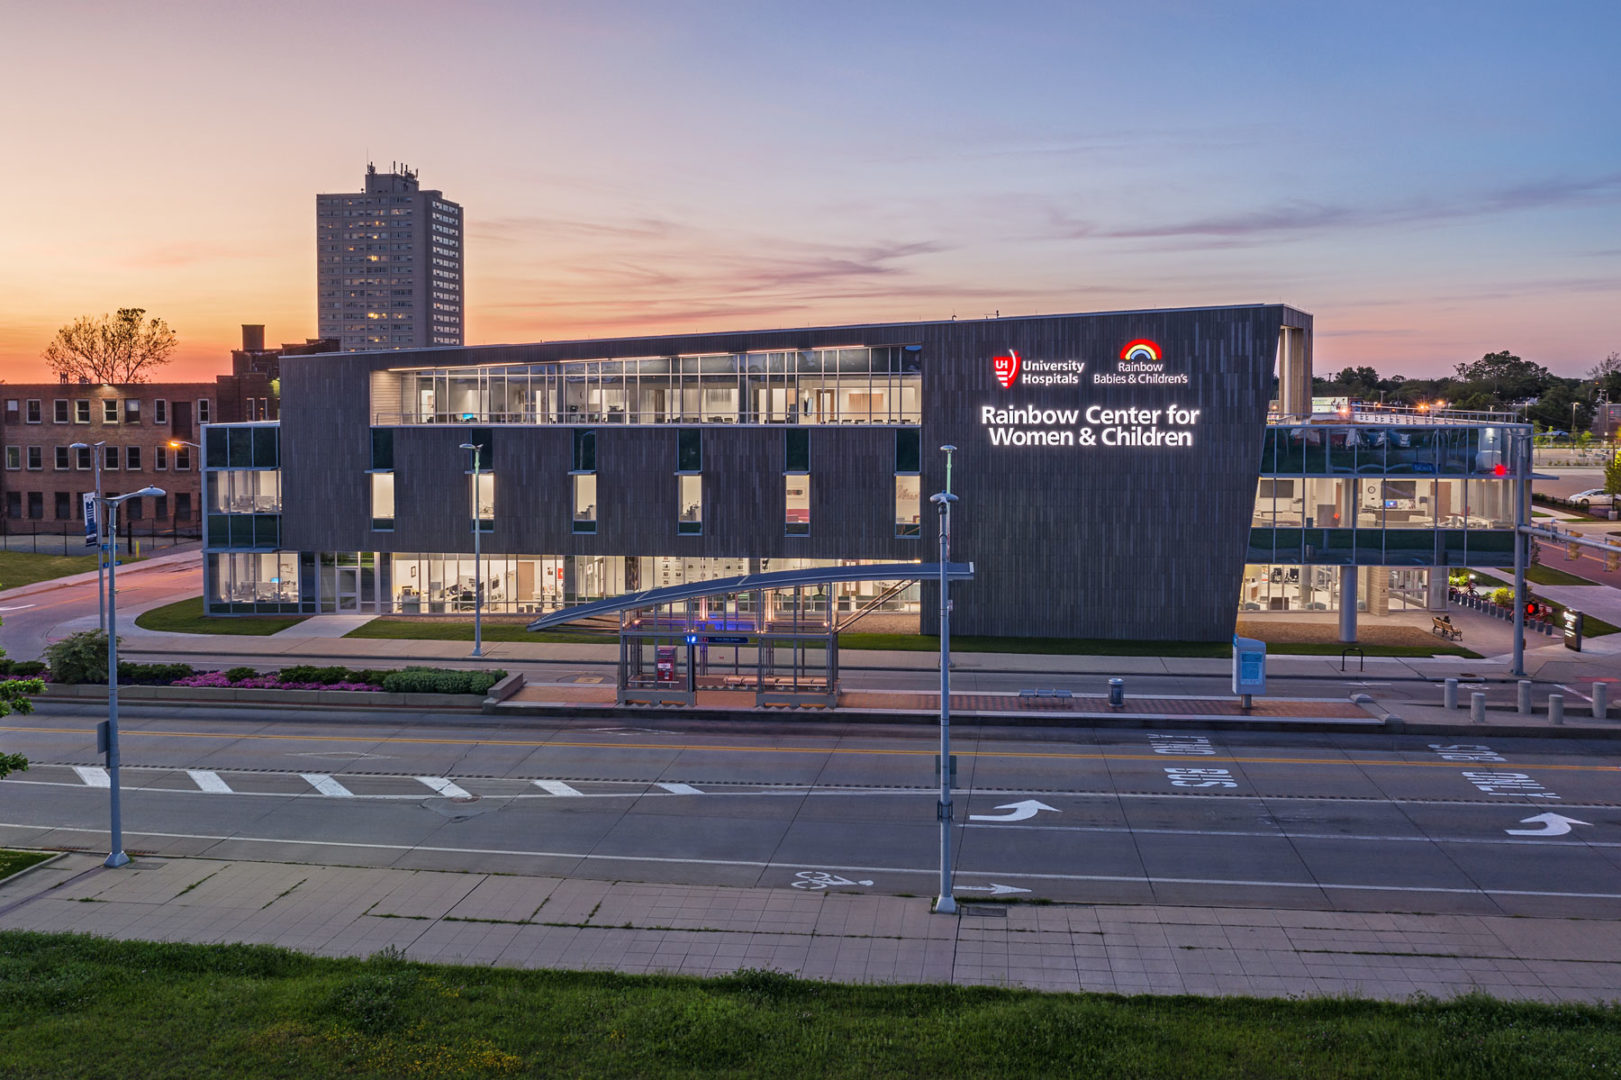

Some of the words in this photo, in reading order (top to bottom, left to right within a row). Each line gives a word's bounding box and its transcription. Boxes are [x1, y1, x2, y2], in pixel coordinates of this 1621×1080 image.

[996, 360, 1008, 369] UH
[1023, 360, 1084, 374] University
[1118, 362, 1163, 372] Rainbow
[1023, 374, 1079, 386] Hospitals
[1094, 374, 1126, 384] Babies
[1128, 375, 1136, 384] &
[982, 405, 1079, 424] Rainbow
[1086, 406, 1161, 424] Center
[1166, 405, 1199, 424] for
[990, 427, 1073, 446] Women
[1079, 427, 1096, 446] &
[1102, 427, 1192, 446] Children
[1163, 767, 1238, 788] BUS
